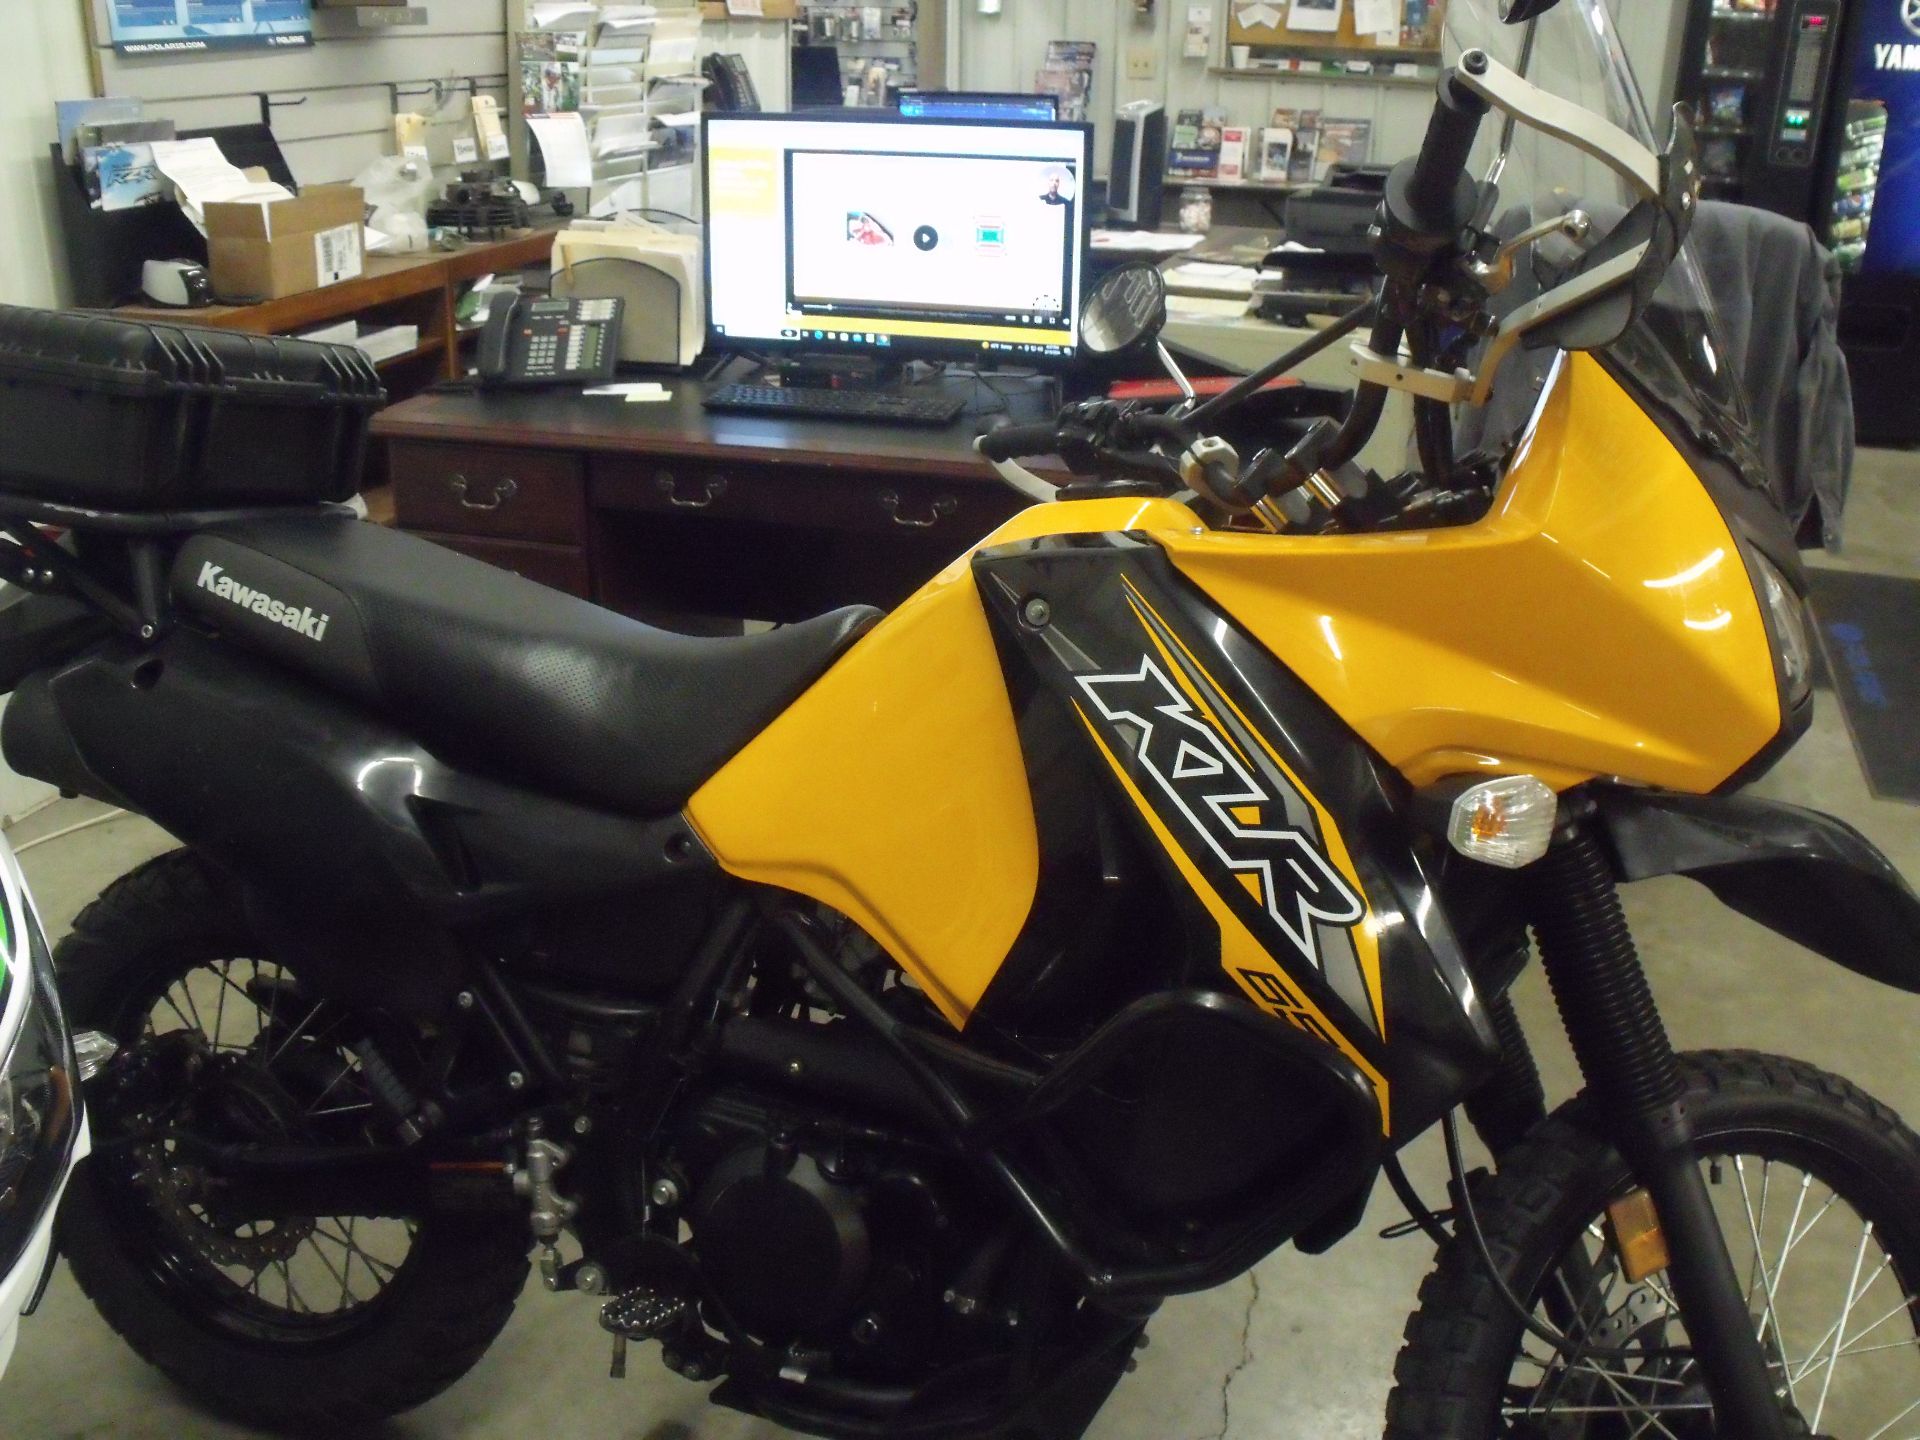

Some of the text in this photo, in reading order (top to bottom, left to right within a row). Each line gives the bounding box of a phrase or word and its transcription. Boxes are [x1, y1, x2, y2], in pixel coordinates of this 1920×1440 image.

[124, 41, 207, 52] WWW.POLARIS.COM
[197, 560, 330, 641] Kawasaki
[1074, 653, 1363, 970] KLR
